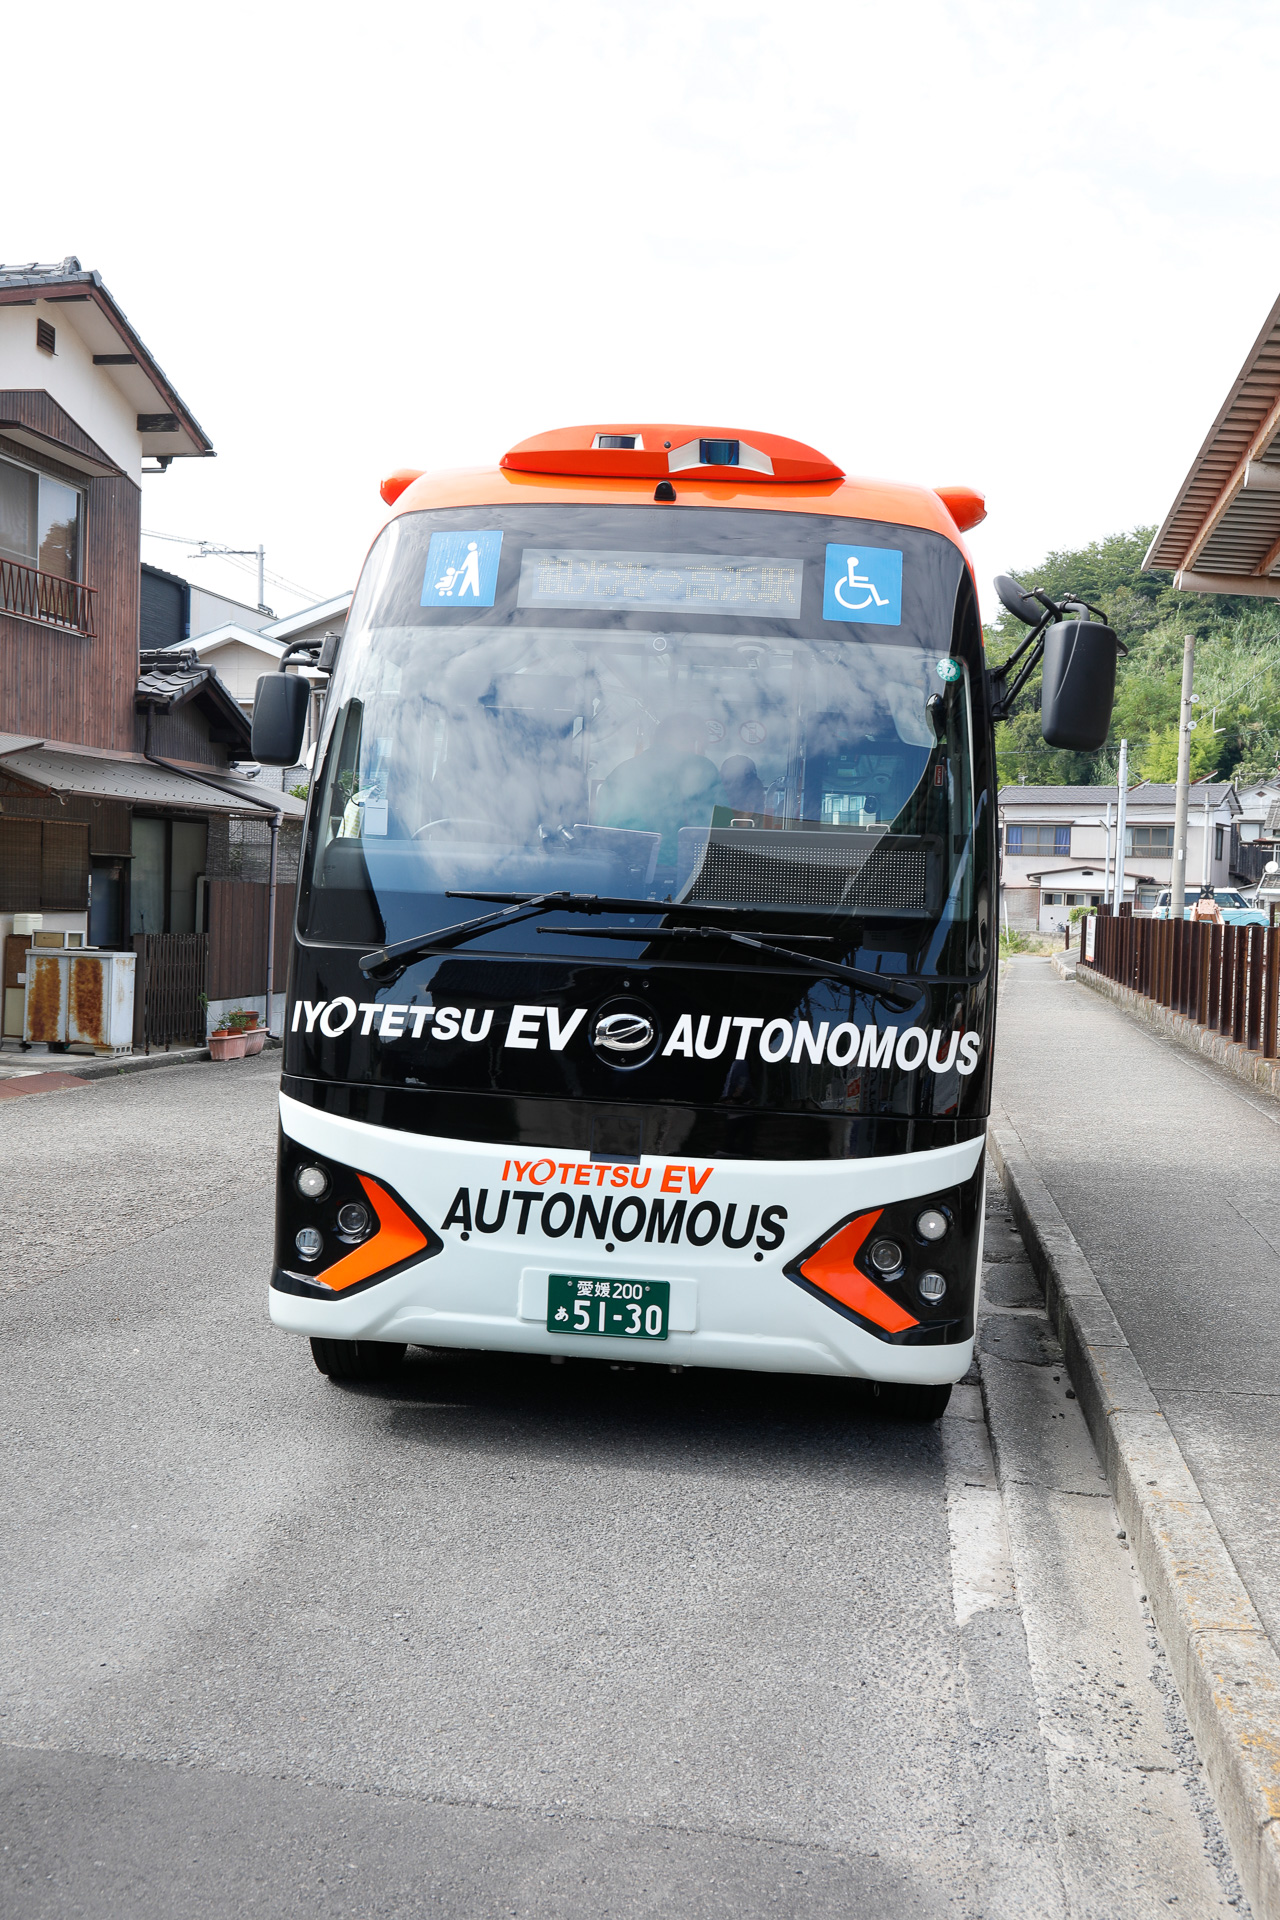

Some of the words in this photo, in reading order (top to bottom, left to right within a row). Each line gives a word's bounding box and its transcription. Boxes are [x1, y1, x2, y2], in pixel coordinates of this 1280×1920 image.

[291, 996, 495, 1043] IYOTETSU
[504, 1005, 588, 1051] EV
[661, 1013, 981, 1076] AUTONOMOUS
[501, 1158, 652, 1189] IYOTETSU
[660, 1164, 715, 1195] EV
[440, 1186, 789, 1251] AUTONOMOUS
